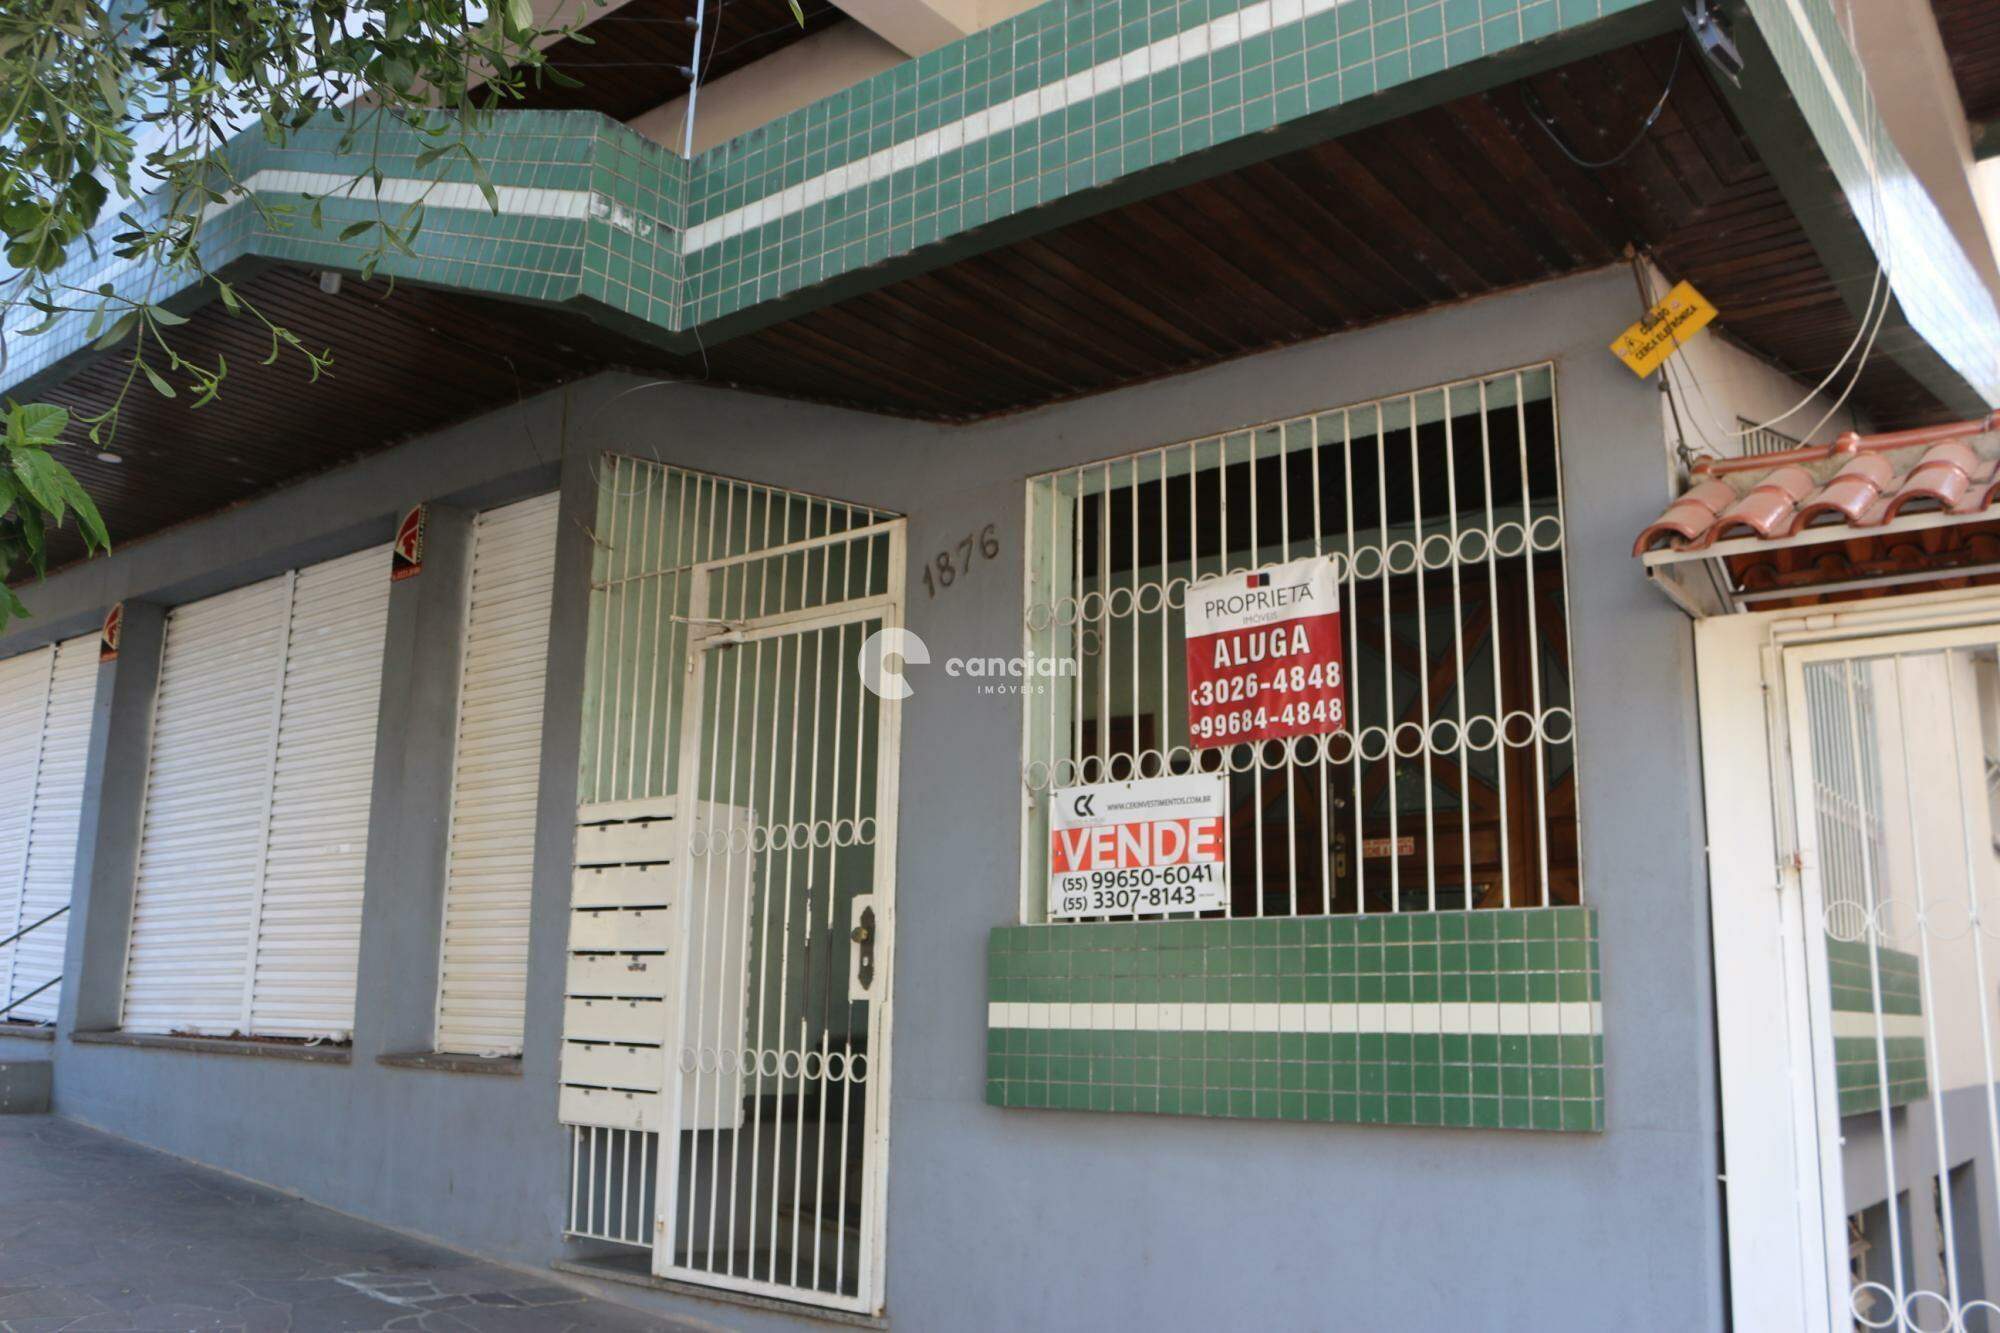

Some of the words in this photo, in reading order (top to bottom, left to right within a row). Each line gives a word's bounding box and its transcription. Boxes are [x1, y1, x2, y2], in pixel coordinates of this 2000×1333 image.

[1640, 308, 1670, 335] CADO
[922, 523, 999, 599] 1876
[1214, 624, 1310, 669] ALUGA
[1200, 661, 1340, 706] 3026-4848
[1200, 698, 1342, 739] 99684-4848
[1074, 794, 1095, 817] CK
[1061, 817, 1217, 871] VENDE
[1062, 876, 1088, 893] (55)
[1091, 864, 1213, 890] 99650-6041
[1063, 896, 1088, 912] (55)
[1093, 886, 1196, 909] 3307-8143
